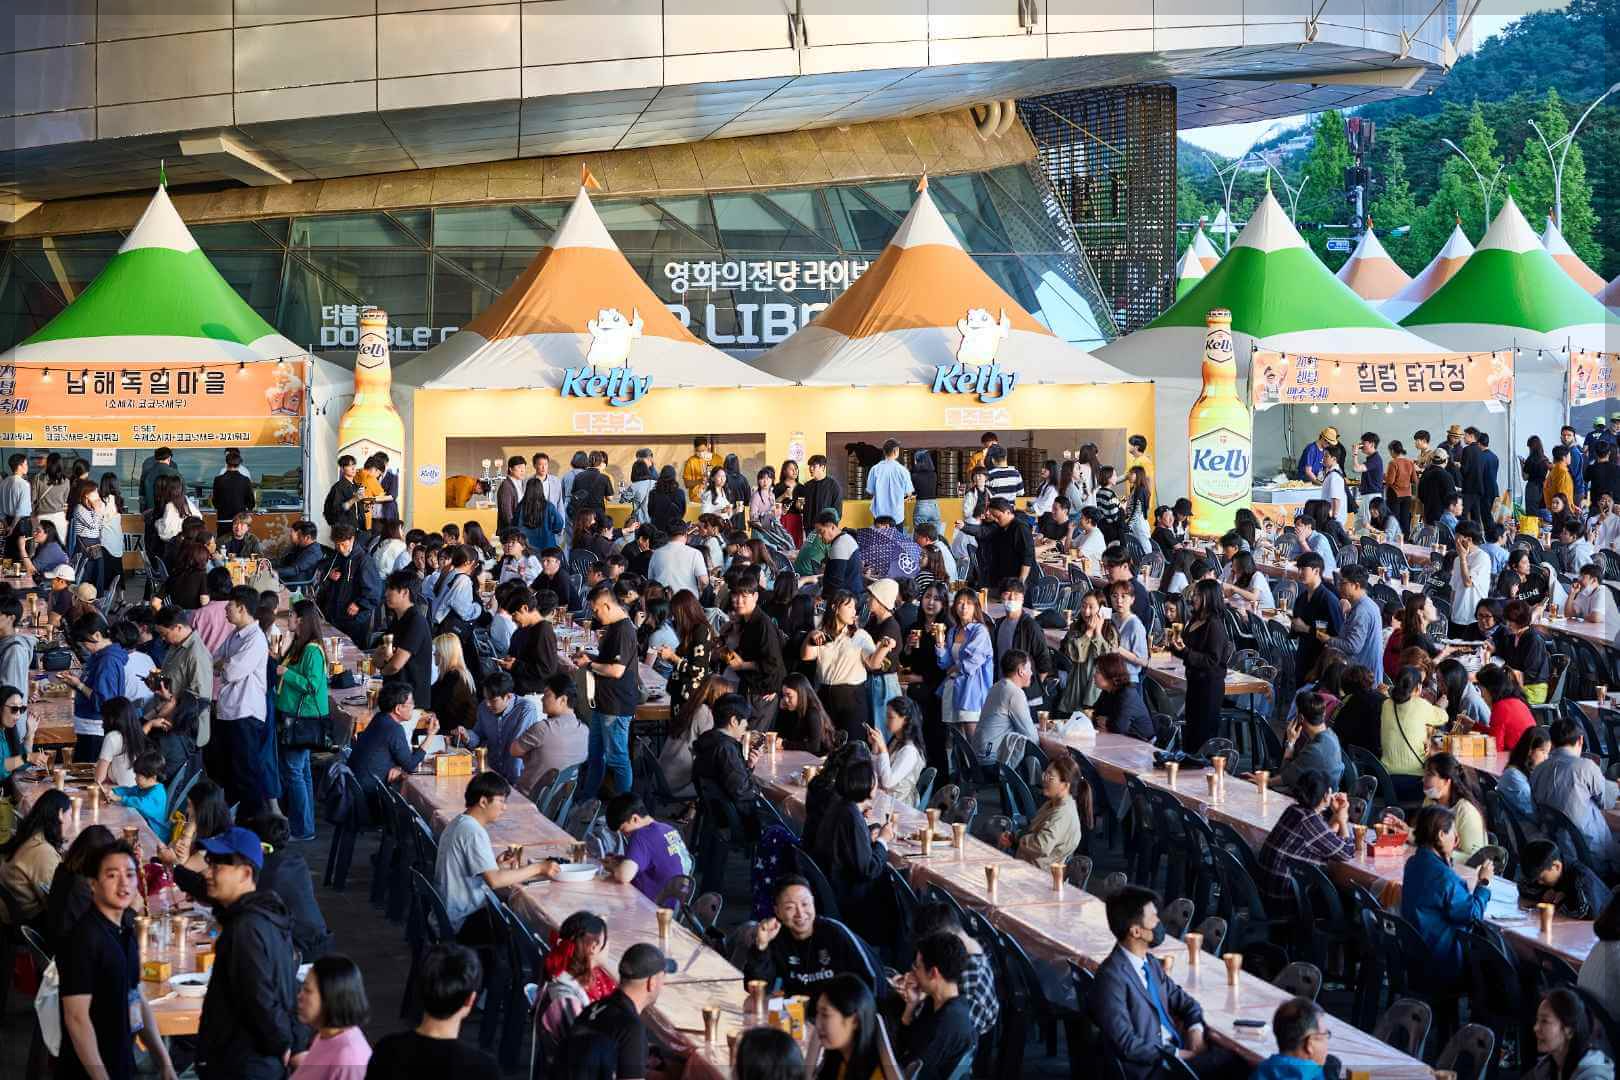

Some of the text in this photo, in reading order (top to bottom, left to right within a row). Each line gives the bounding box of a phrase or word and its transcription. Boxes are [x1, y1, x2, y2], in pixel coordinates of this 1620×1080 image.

[322, 304, 377, 325] 더블
[560, 367, 653, 407] Kelly
[932, 361, 1021, 404] Kelly
[1406, 363, 1465, 392] 닭강정
[1193, 448, 1250, 478] Kelly
